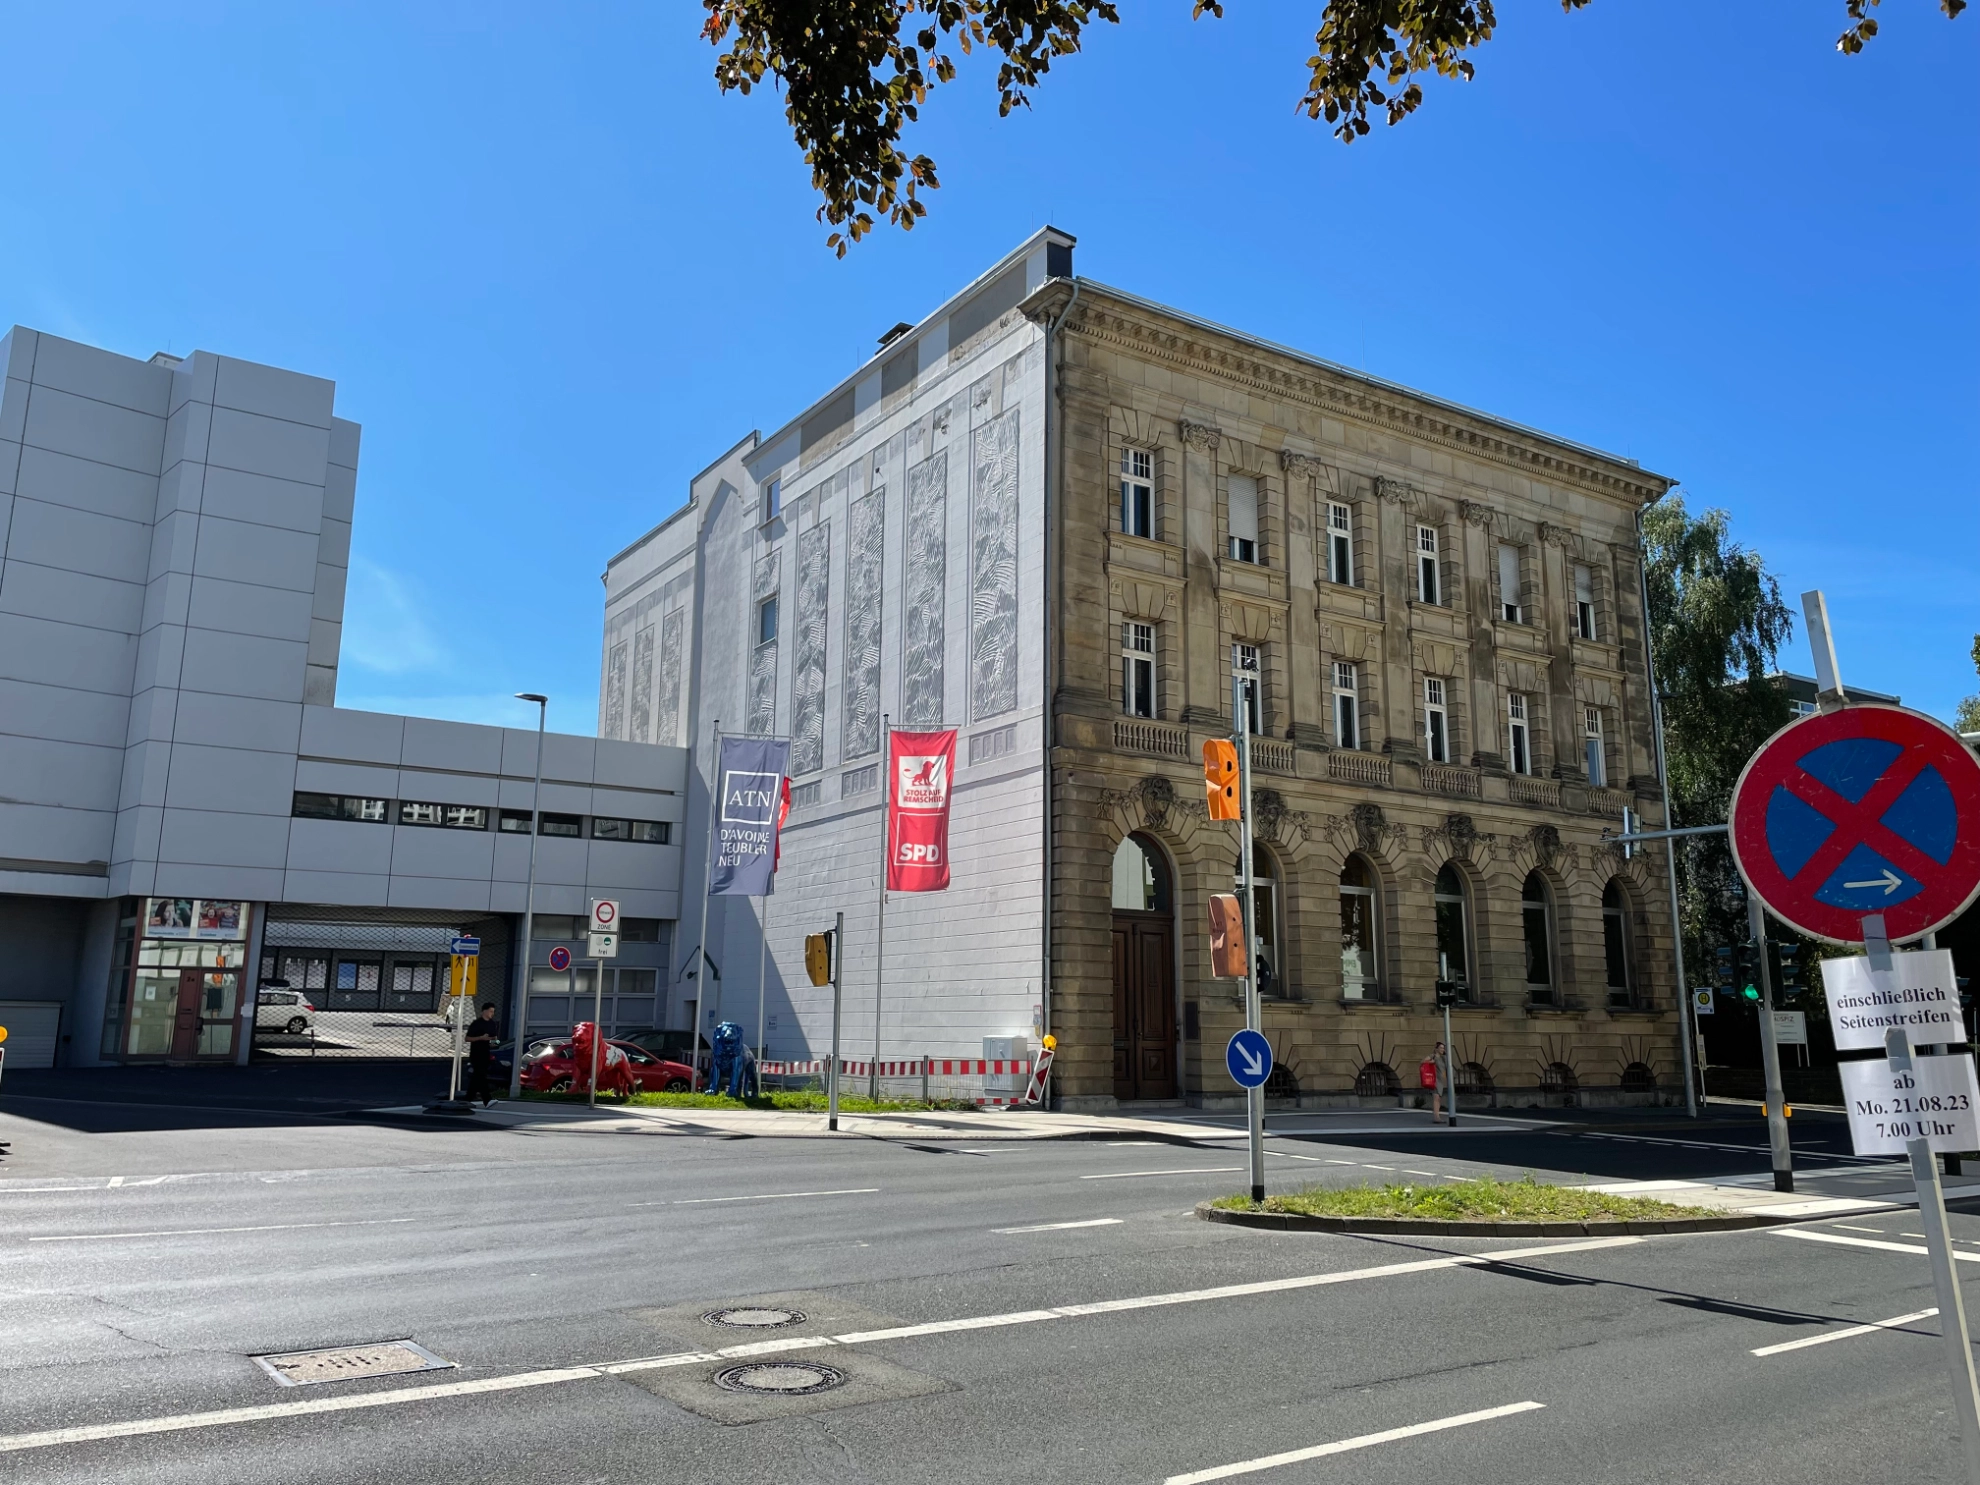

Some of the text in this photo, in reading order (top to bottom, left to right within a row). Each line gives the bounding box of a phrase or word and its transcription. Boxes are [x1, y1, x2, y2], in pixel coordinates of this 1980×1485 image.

[728, 790, 772, 807] ATN
[905, 789, 942, 797] STOLZ AUF
[720, 829, 770, 843] D'AVOINE
[721, 842, 767, 855] TEUBLER
[899, 843, 939, 862] SPD
[718, 855, 741, 867] NEU
[1837, 987, 1946, 1009] einschließlich
[1840, 1009, 1950, 1030] Seitenstreifen
[1893, 1074, 1915, 1089] ab
[1856, 1095, 1969, 1115] Mo. 21.08.23
[1876, 1120, 1956, 1138] 7.00 Uhr
